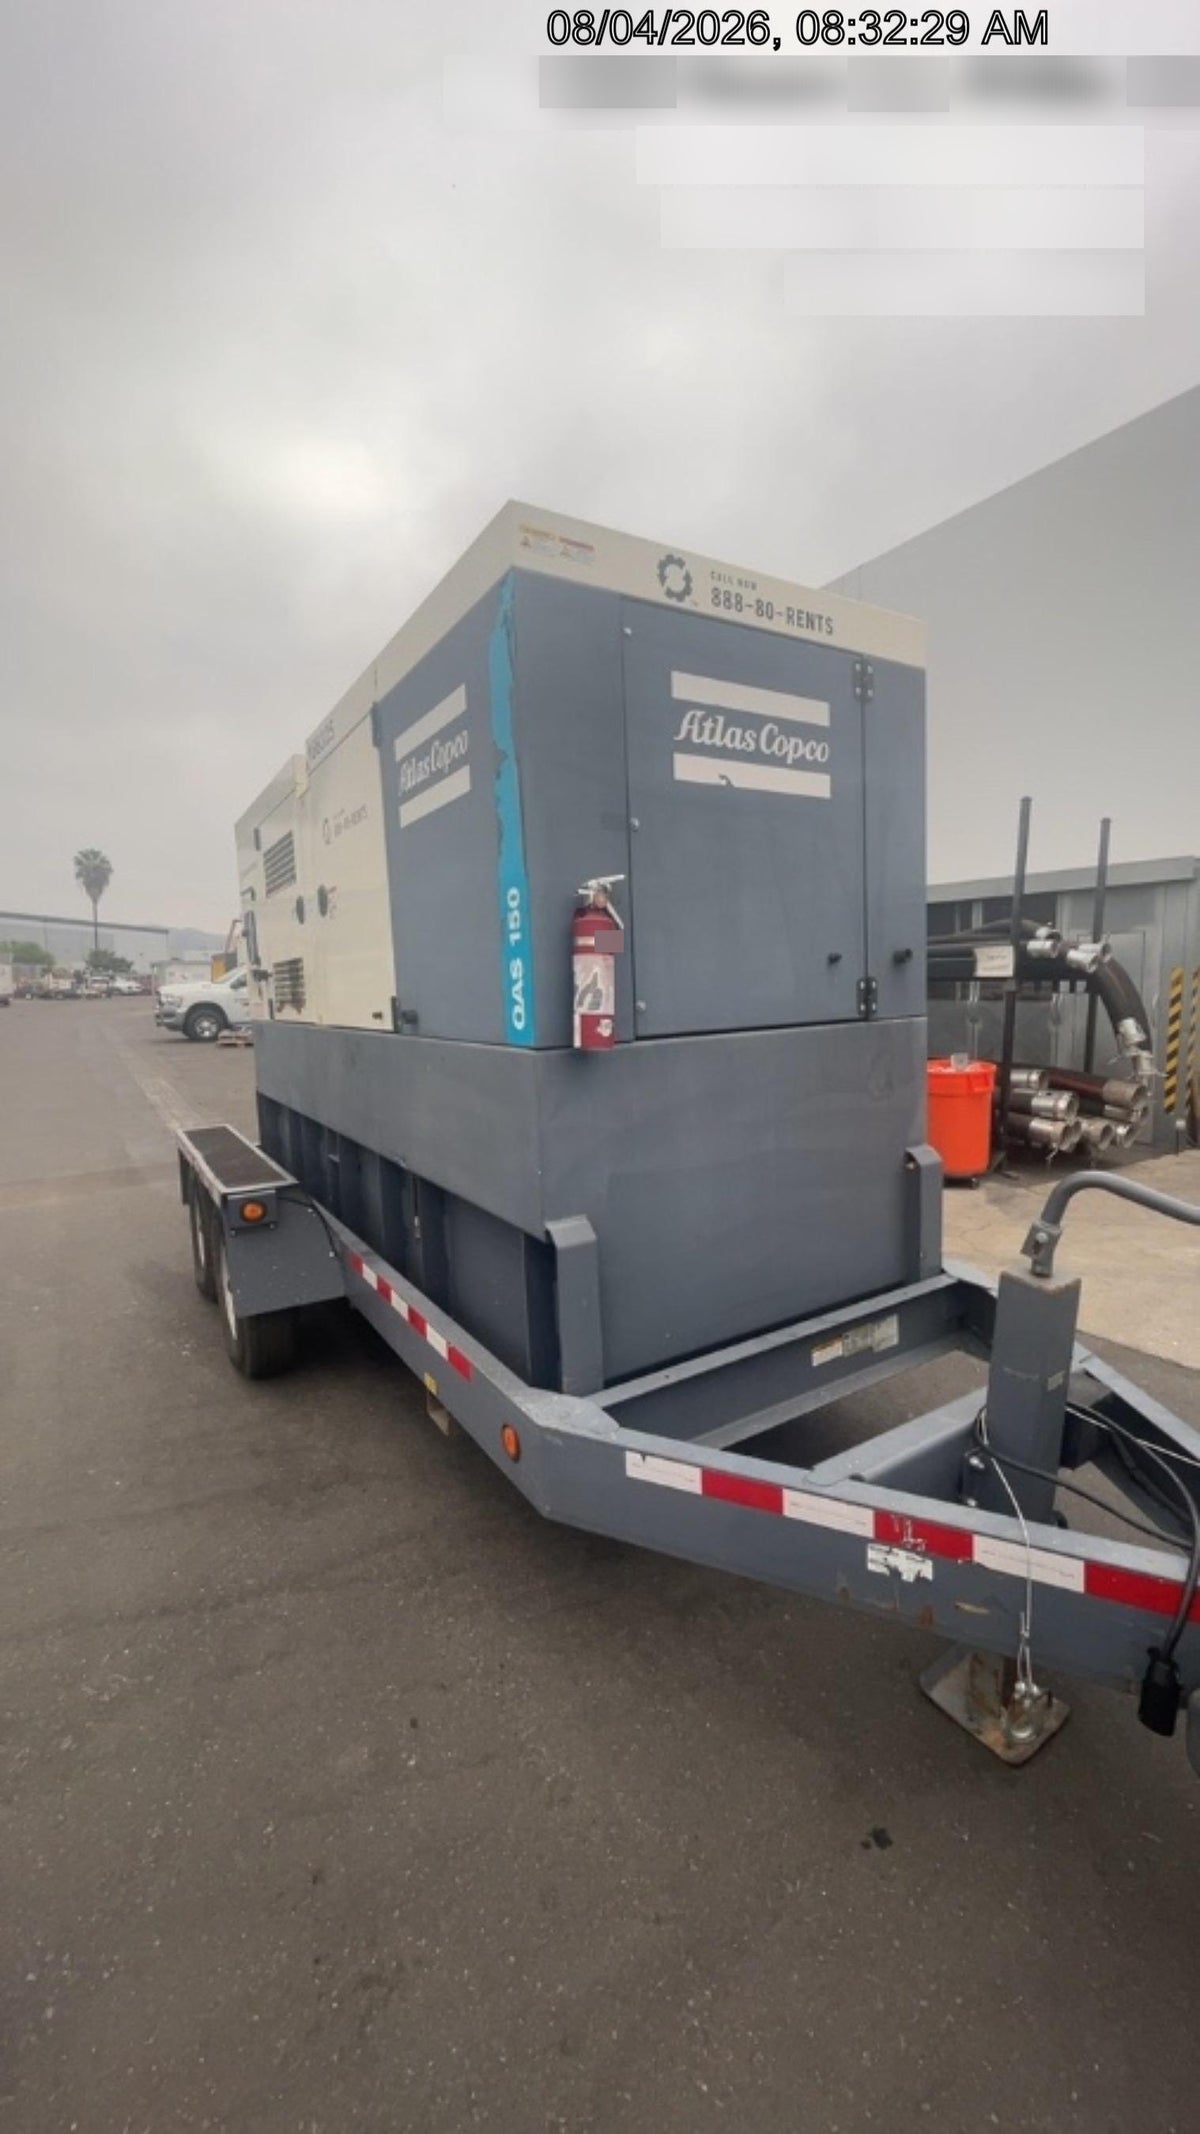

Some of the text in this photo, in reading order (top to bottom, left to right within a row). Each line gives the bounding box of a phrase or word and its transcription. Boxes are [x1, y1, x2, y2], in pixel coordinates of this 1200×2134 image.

[711, 587, 834, 635] 888-80-RENTS
[398, 730, 468, 797] Atlas Copco
[673, 709, 829, 764] Atlas Copco
[507, 886, 525, 1031] QAS 150
